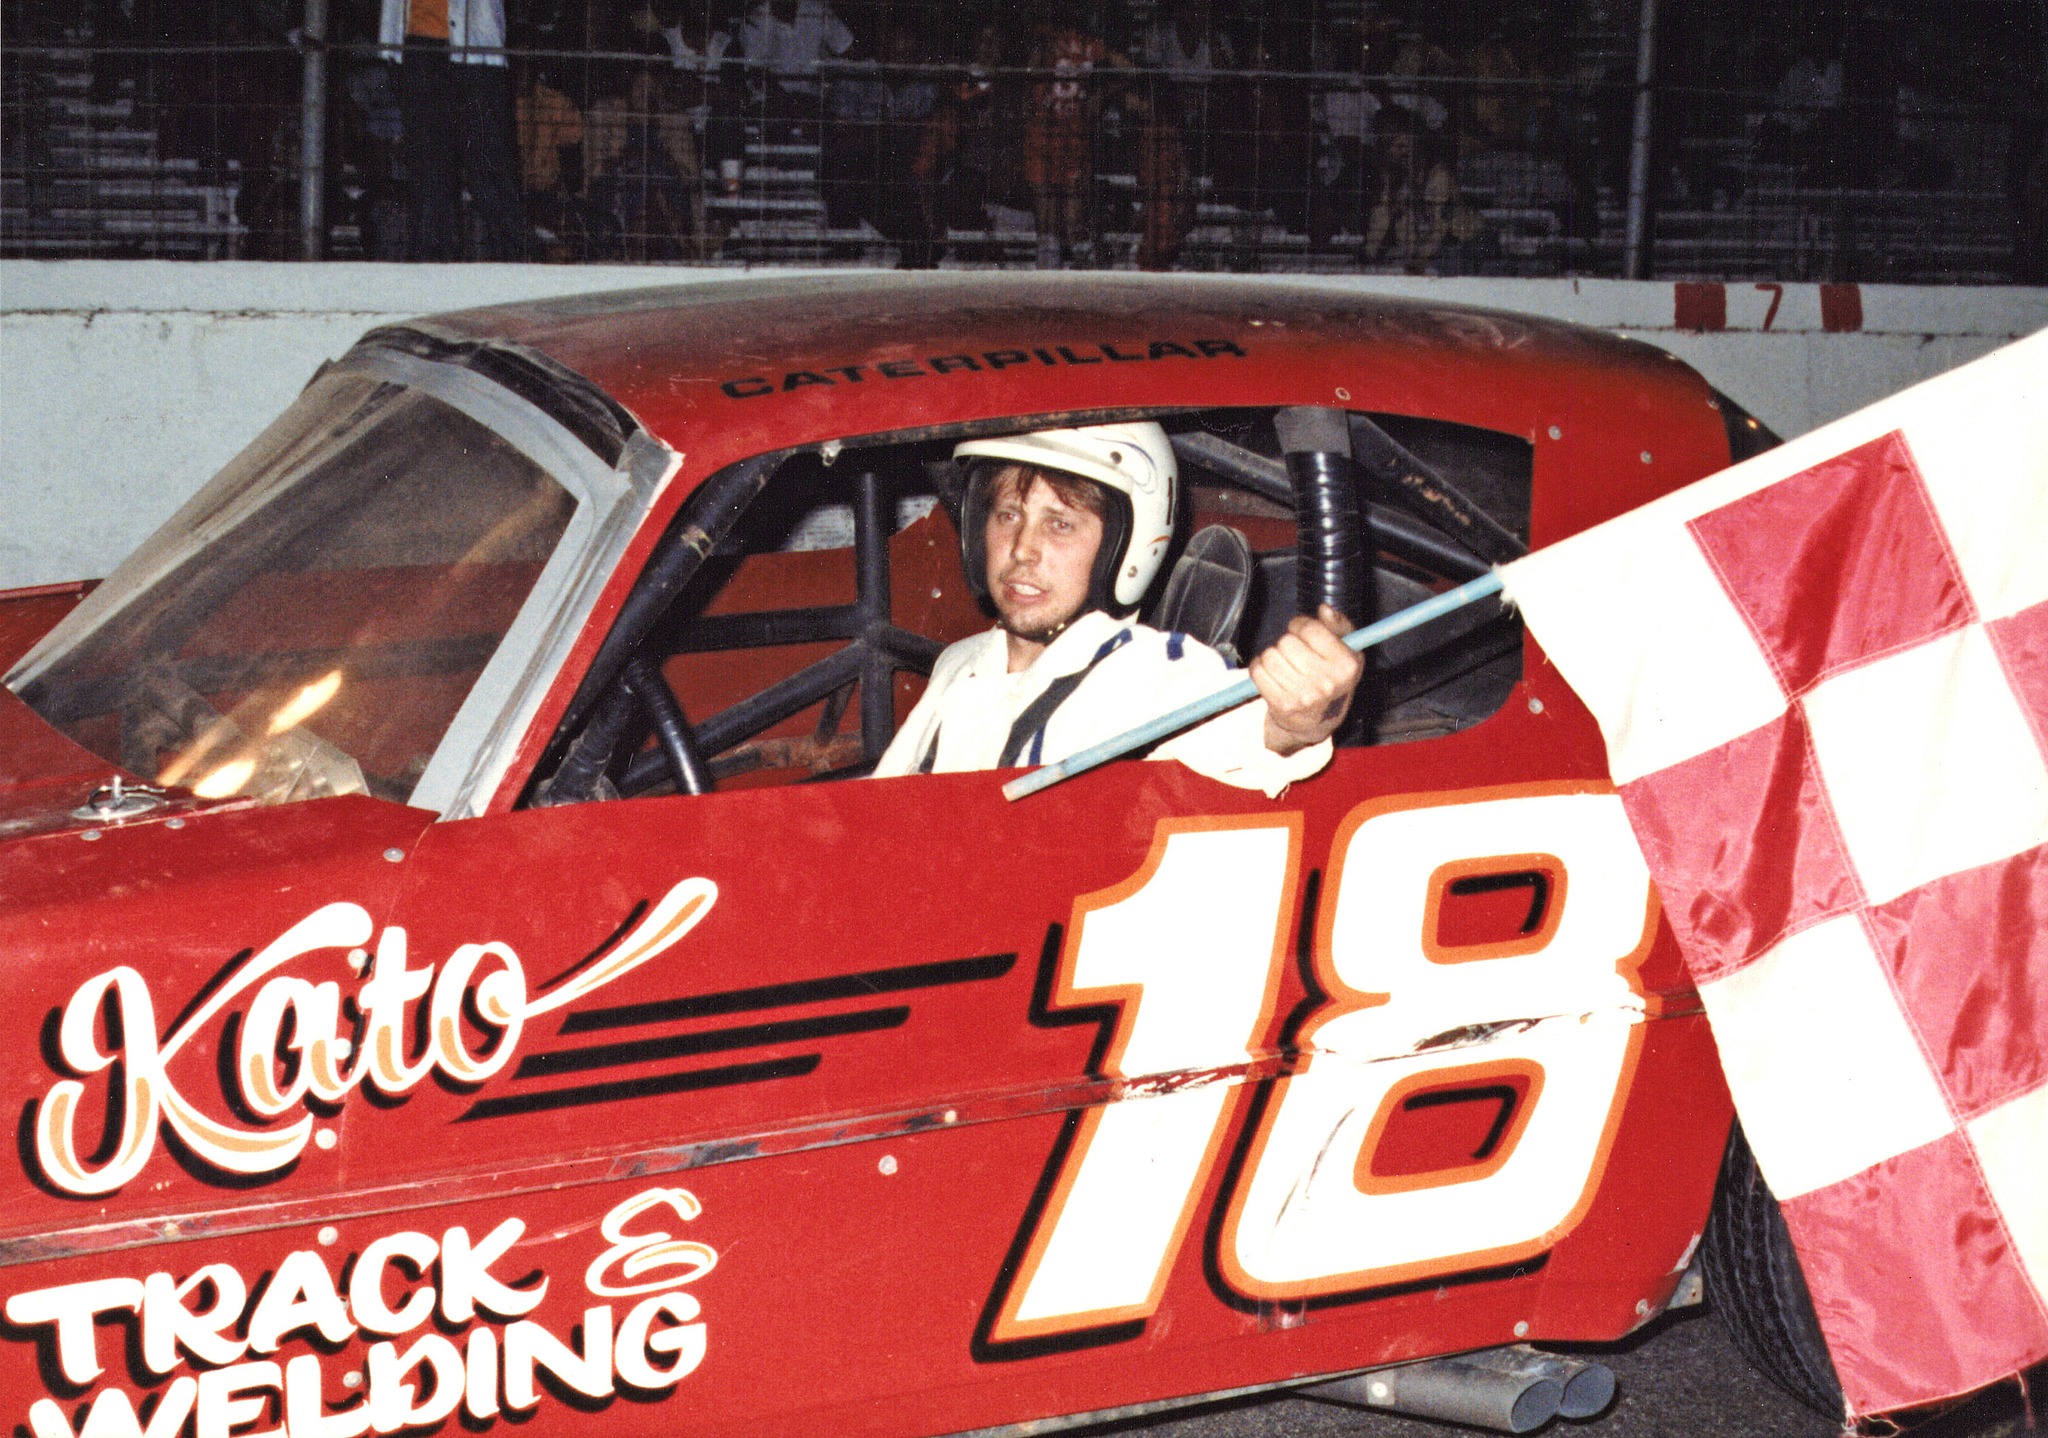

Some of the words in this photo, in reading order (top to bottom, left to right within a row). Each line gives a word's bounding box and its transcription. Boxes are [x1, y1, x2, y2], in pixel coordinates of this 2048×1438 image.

[721, 338, 1248, 400] CATERPILLAR
[1755, 283, 1782, 332] 7
[36, 876, 719, 1195] Kato
[993, 780, 1663, 1341] 18
[6, 1217, 549, 1385] TRACK
[586, 1187, 719, 1297] &
[28, 1292, 707, 1438] WELDING
